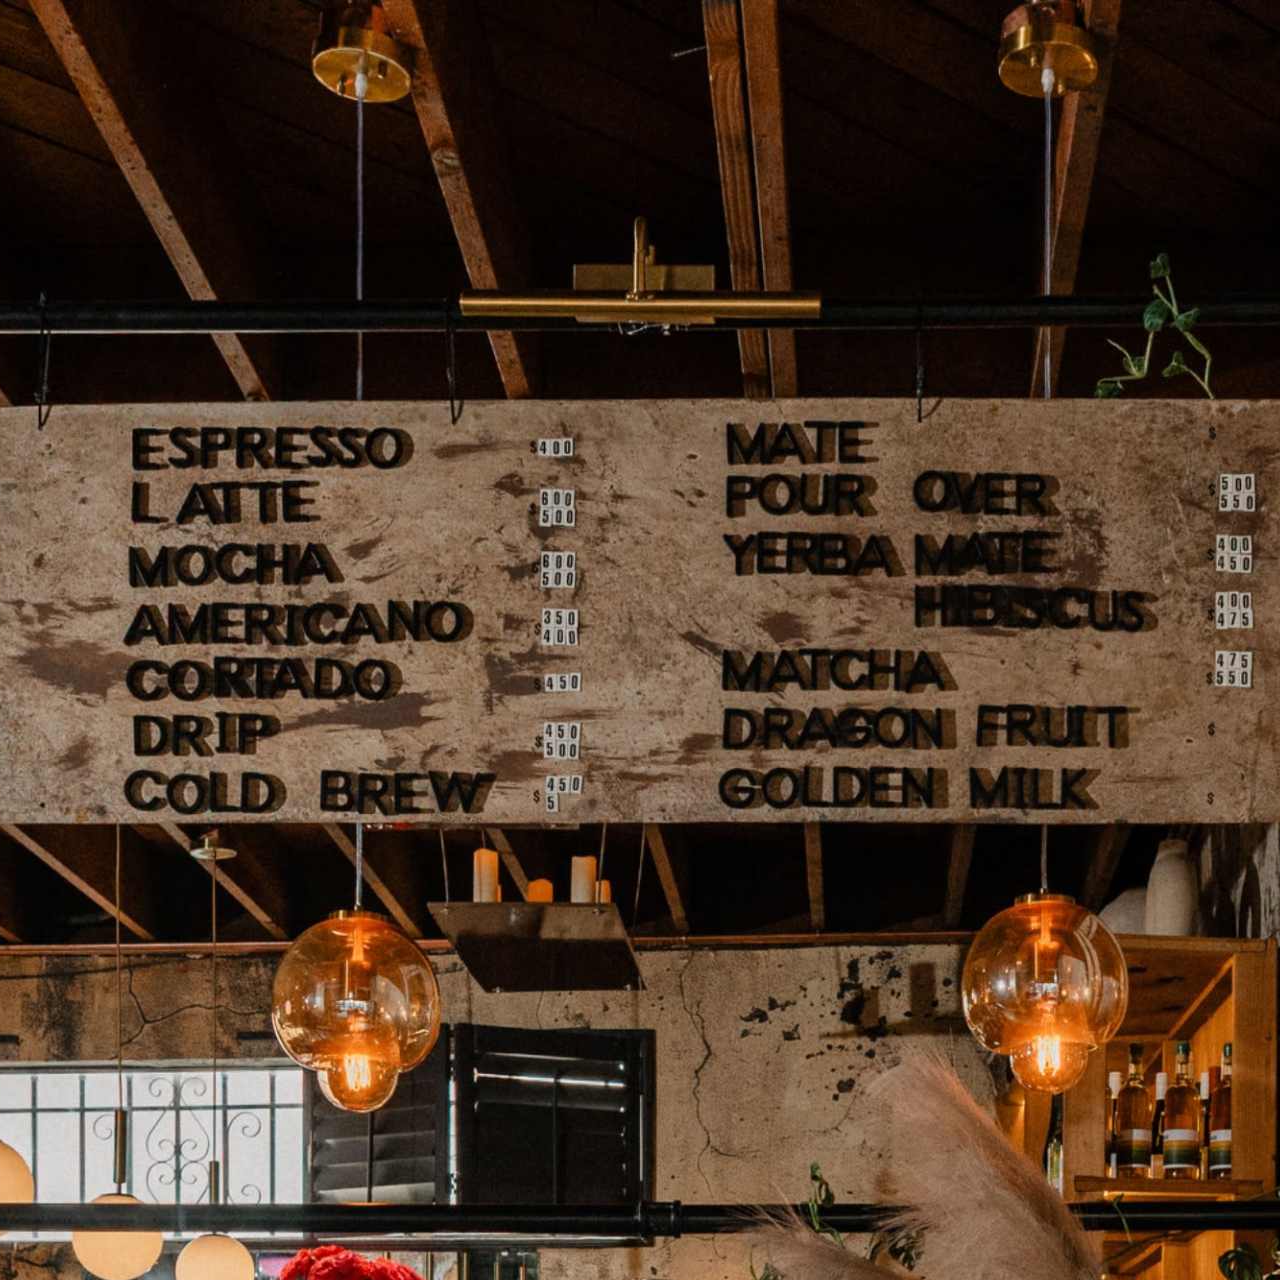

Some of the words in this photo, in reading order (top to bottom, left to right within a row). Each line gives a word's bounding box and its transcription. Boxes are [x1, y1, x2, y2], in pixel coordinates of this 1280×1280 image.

[131, 426, 413, 470] ESPRESSO
[726, 421, 879, 465] MATE
[131, 480, 320, 524] LATTE
[726, 472, 878, 517] POUR
[913, 470, 1061, 516] OVER
[127, 542, 344, 588] MOCHA
[723, 531, 907, 577] YERBA
[915, 530, 1063, 576] MATE
[124, 600, 473, 646] AMERICANO
[915, 583, 1158, 631] HIBISCUS
[126, 655, 402, 701] CORTADO
[723, 648, 959, 692] MATCHA
[133, 711, 282, 756] DRIP
[723, 707, 956, 750] DRAGON
[977, 704, 1141, 748] FRUIT
[124, 769, 286, 814] COLD
[320, 769, 496, 814] BREW
[720, 766, 948, 808] GOLDEN
[969, 766, 1101, 809] MILK
